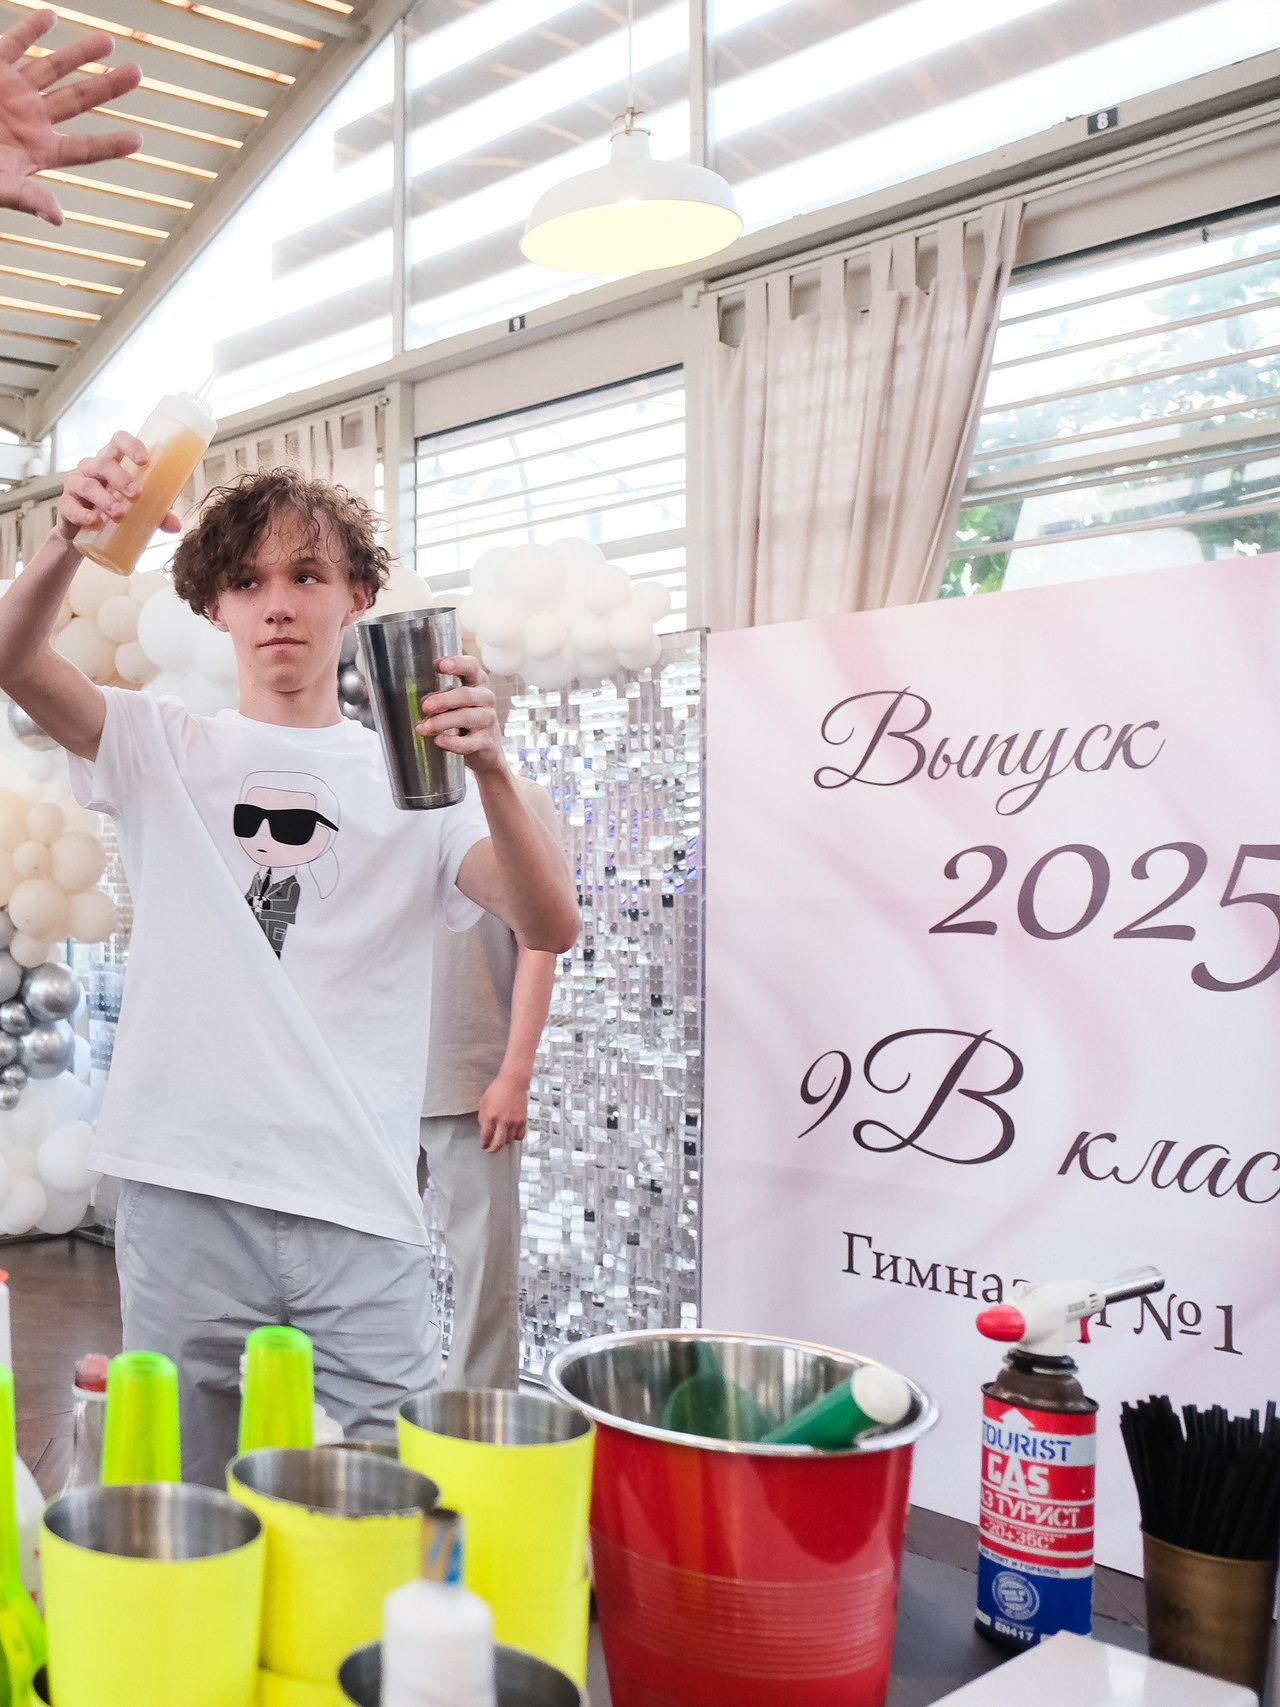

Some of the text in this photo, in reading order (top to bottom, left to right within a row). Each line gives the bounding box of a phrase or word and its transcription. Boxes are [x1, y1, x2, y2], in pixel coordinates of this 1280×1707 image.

[1097, 112, 1109, 130] 8
[813, 685, 1167, 816] Выпуск
[928, 841, 1280, 992] 2025
[841, 1231, 1112, 1328] Гимна
[982, 1419, 1072, 1462] TOURIST
[987, 1452, 1050, 1498] GAS
[995, 1493, 1081, 1528] ТУРИСТ
[994, 1620, 1034, 1642] EN417
